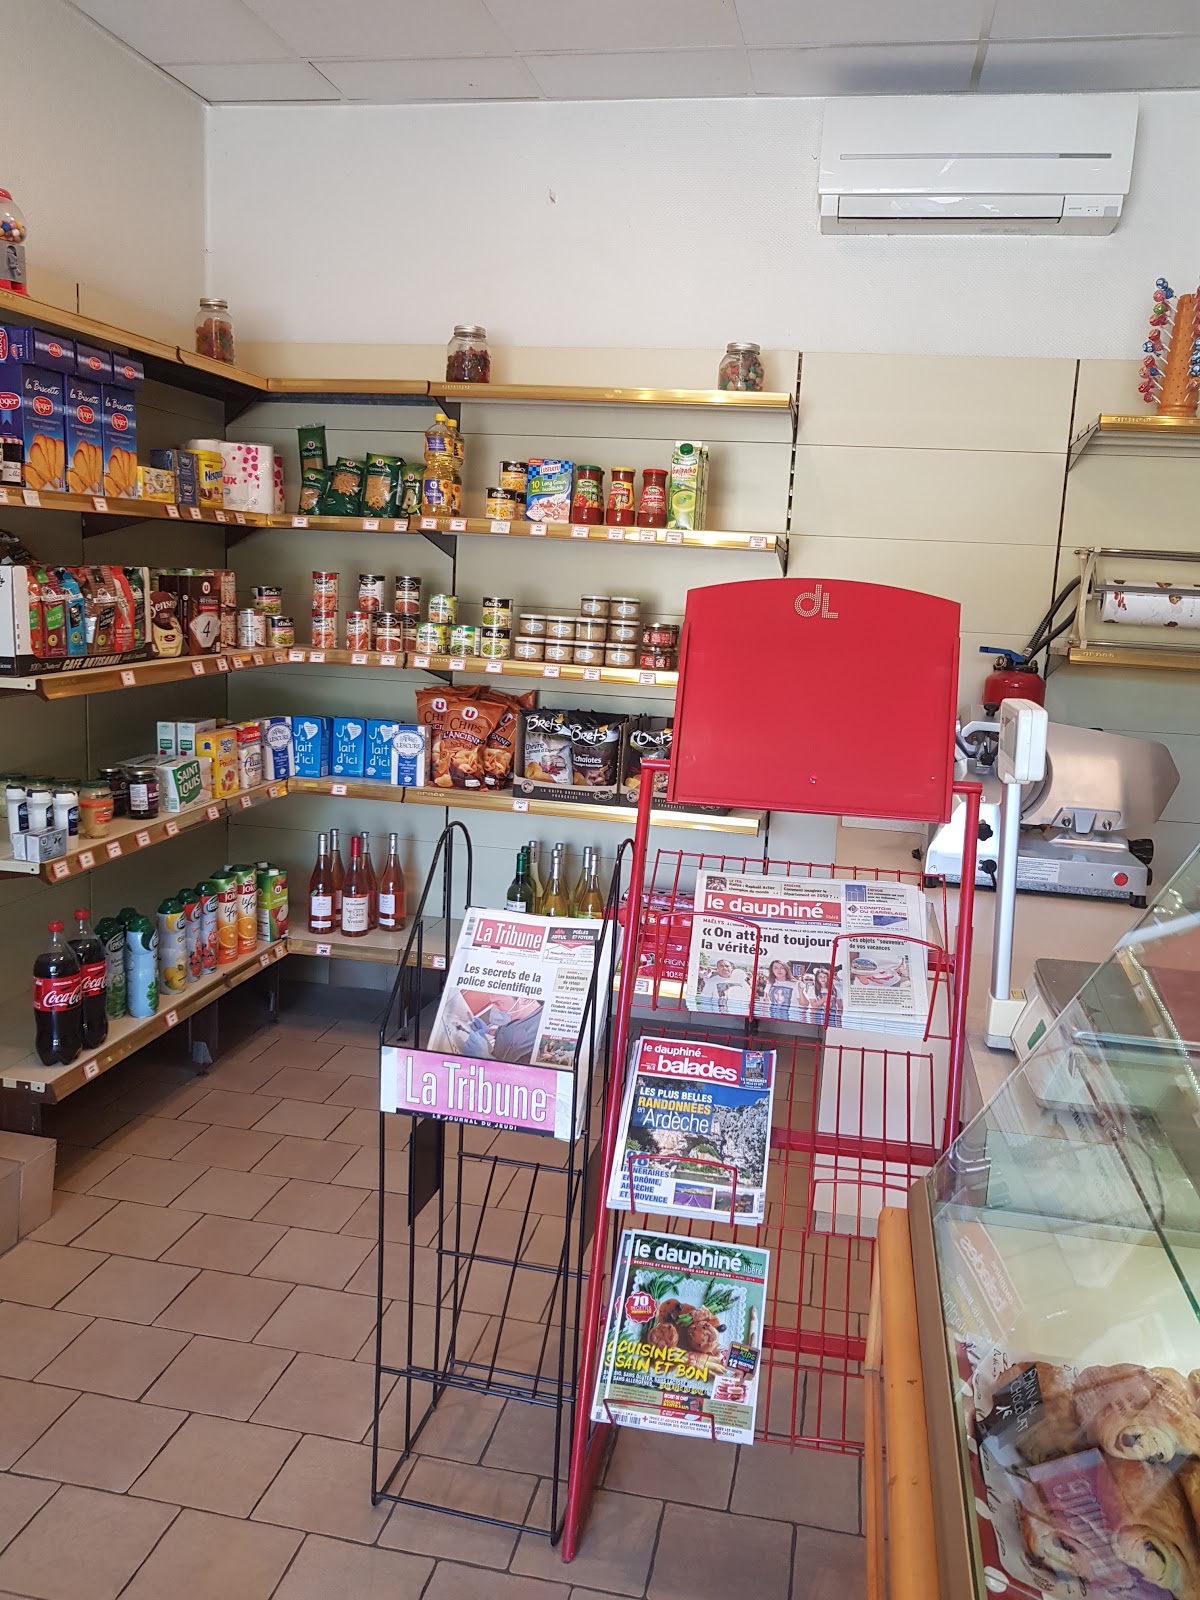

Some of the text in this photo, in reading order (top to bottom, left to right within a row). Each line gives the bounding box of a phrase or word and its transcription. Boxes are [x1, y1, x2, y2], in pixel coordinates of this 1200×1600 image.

[33, 380, 60, 395] Biscotte
[0, 398, 19, 411] oger
[205, 470, 222, 482] Nesqu
[424, 711, 444, 724] CHI
[464, 709, 476, 719] U
[295, 740, 313, 753] lait
[338, 740, 356, 753] lait
[371, 742, 389, 756] lait
[294, 752, 314, 765] d'ici
[337, 752, 358, 765] d'ici
[369, 754, 390, 767] d'ici
[177, 762, 199, 784] SAINT
[180, 775, 200, 797] LOUIS
[242, 883, 257, 894] JOK
[707, 894, 724, 910] le
[729, 897, 823, 919] dauphiné
[476, 920, 543, 949] La Tribune
[701, 939, 713, 951] la
[464, 963, 541, 983] Les secrets de la
[456, 976, 542, 996] police scientifique
[643, 1043, 702, 1058] le dauphiné
[657, 1055, 738, 1082] balades
[405, 1056, 547, 1122] La Tribune
[639, 1087, 713, 1103] LES PLUS BELLES
[637, 1096, 712, 1115] RANDONNÉES
[443, 1115, 478, 1125] JOURNAL
[494, 1122, 517, 1131] JEUDI
[637, 1106, 709, 1134] en Ardèche
[624, 1165, 670, 1178] INÉRAIRES
[634, 1193, 669, 1204] ROVENCE
[634, 1239, 763, 1276] le dauphiné libéré
[632, 1296, 649, 1306] 70
[617, 1340, 687, 1363] CUISINEZ
[615, 1355, 708, 1383] SAIN ET BON
[728, 1358, 738, 1368] 12
[1022, 1368, 1038, 1400] PAIN
